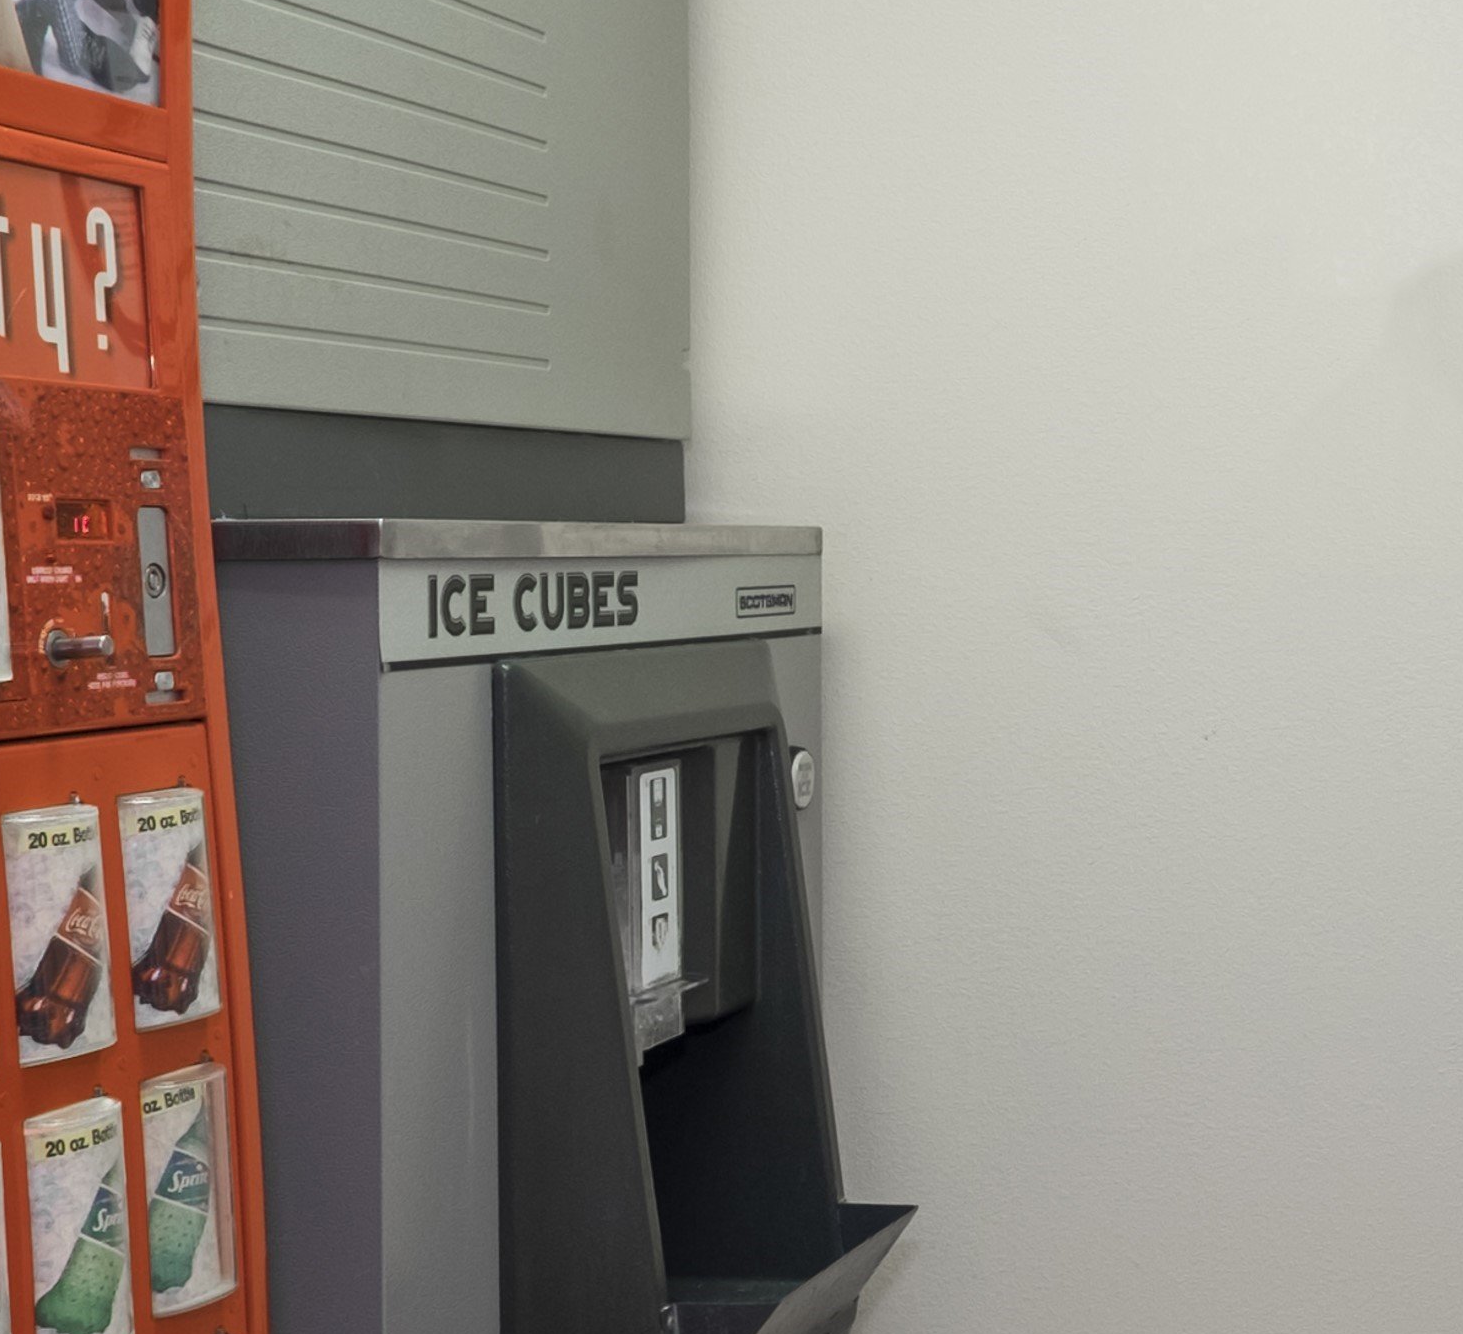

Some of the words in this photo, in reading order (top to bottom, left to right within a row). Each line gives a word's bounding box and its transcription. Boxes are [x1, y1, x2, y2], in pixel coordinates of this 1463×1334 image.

[427, 573, 496, 639] ICE
[512, 570, 639, 633] CUBES
[137, 815, 156, 833] 20
[27, 831, 48, 849] 20
[142, 1099, 163, 1114] oz.
[44, 1138, 66, 1158] 20
[70, 1136, 90, 1152] oz.
